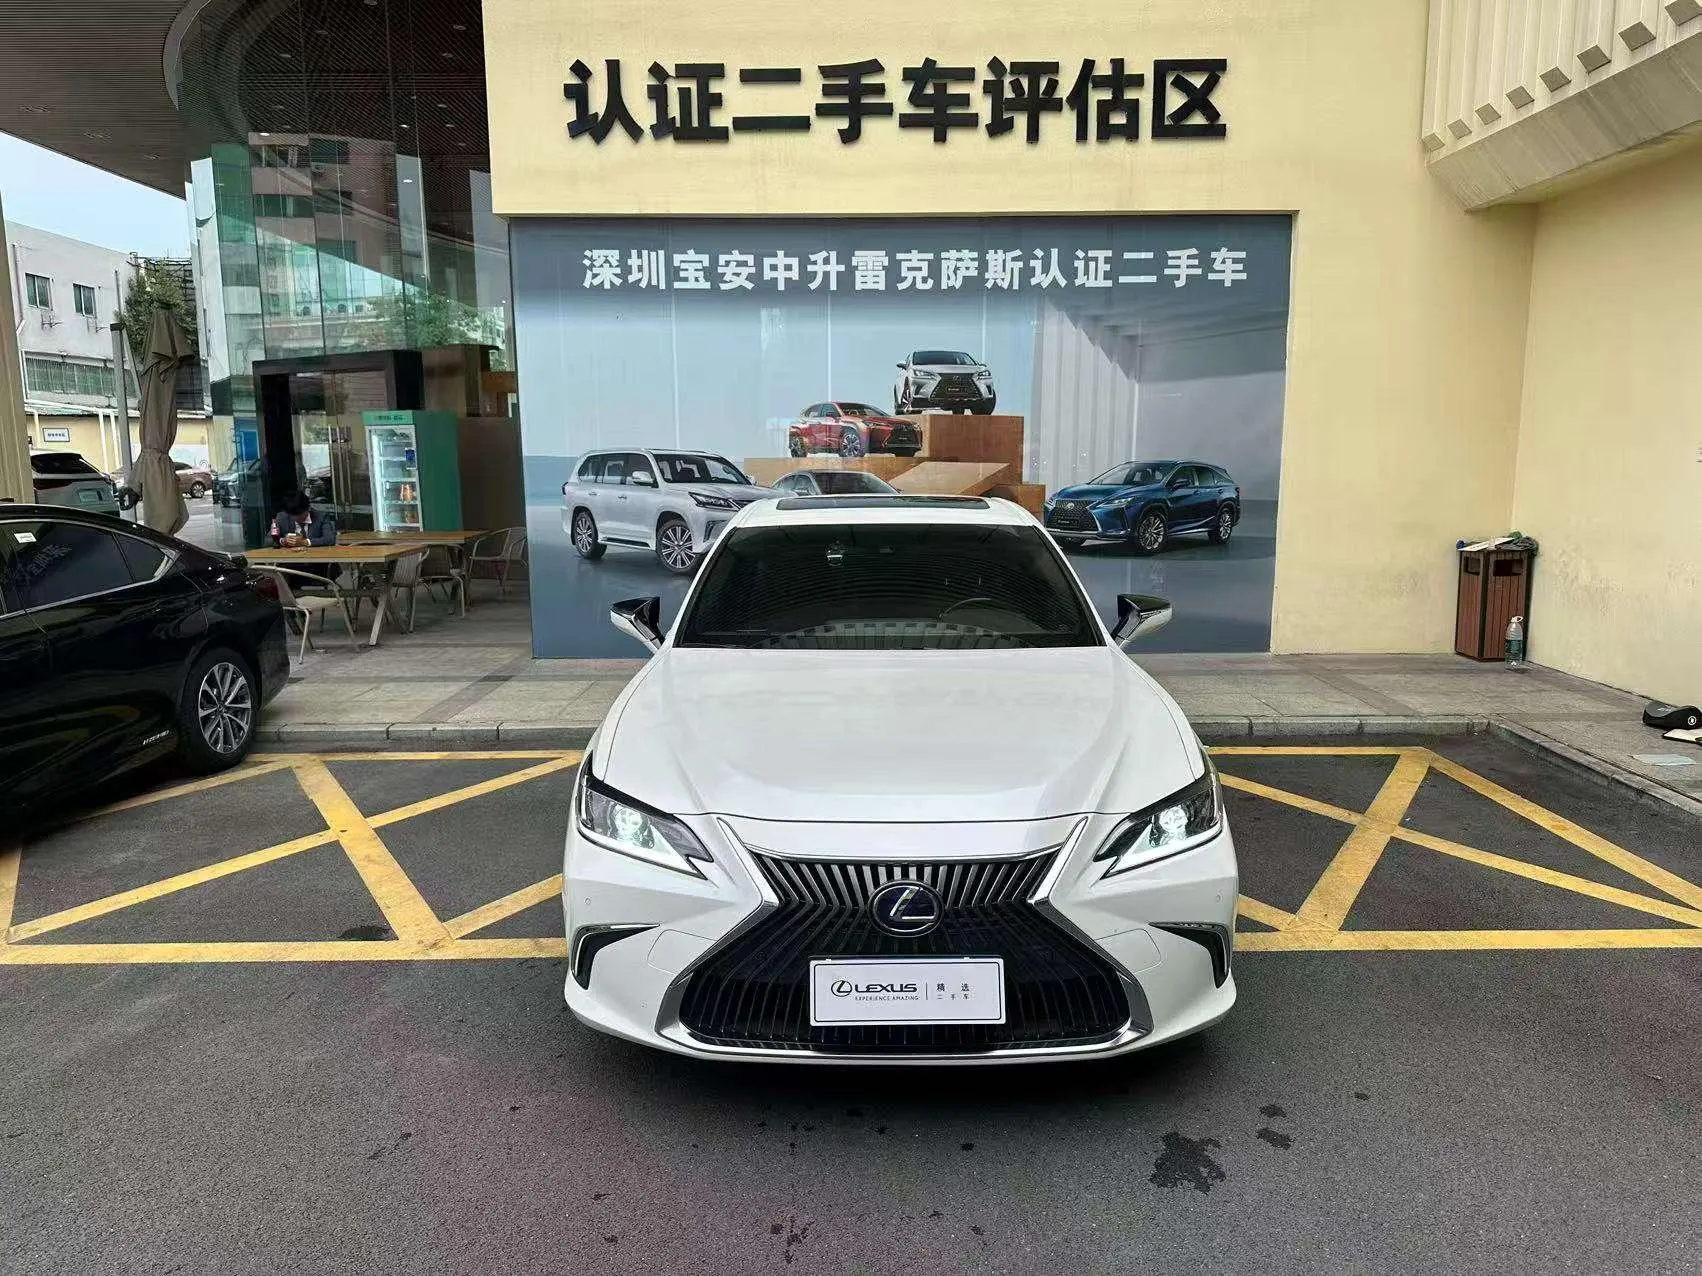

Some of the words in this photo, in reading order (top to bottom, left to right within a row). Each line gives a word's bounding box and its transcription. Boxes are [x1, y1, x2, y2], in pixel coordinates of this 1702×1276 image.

[563, 56, 1228, 143] 认证二手车评估区
[581, 248, 1248, 292] 深圳宝安中升雷克萨斯认证二手车
[854, 983, 918, 993] LEXUS
